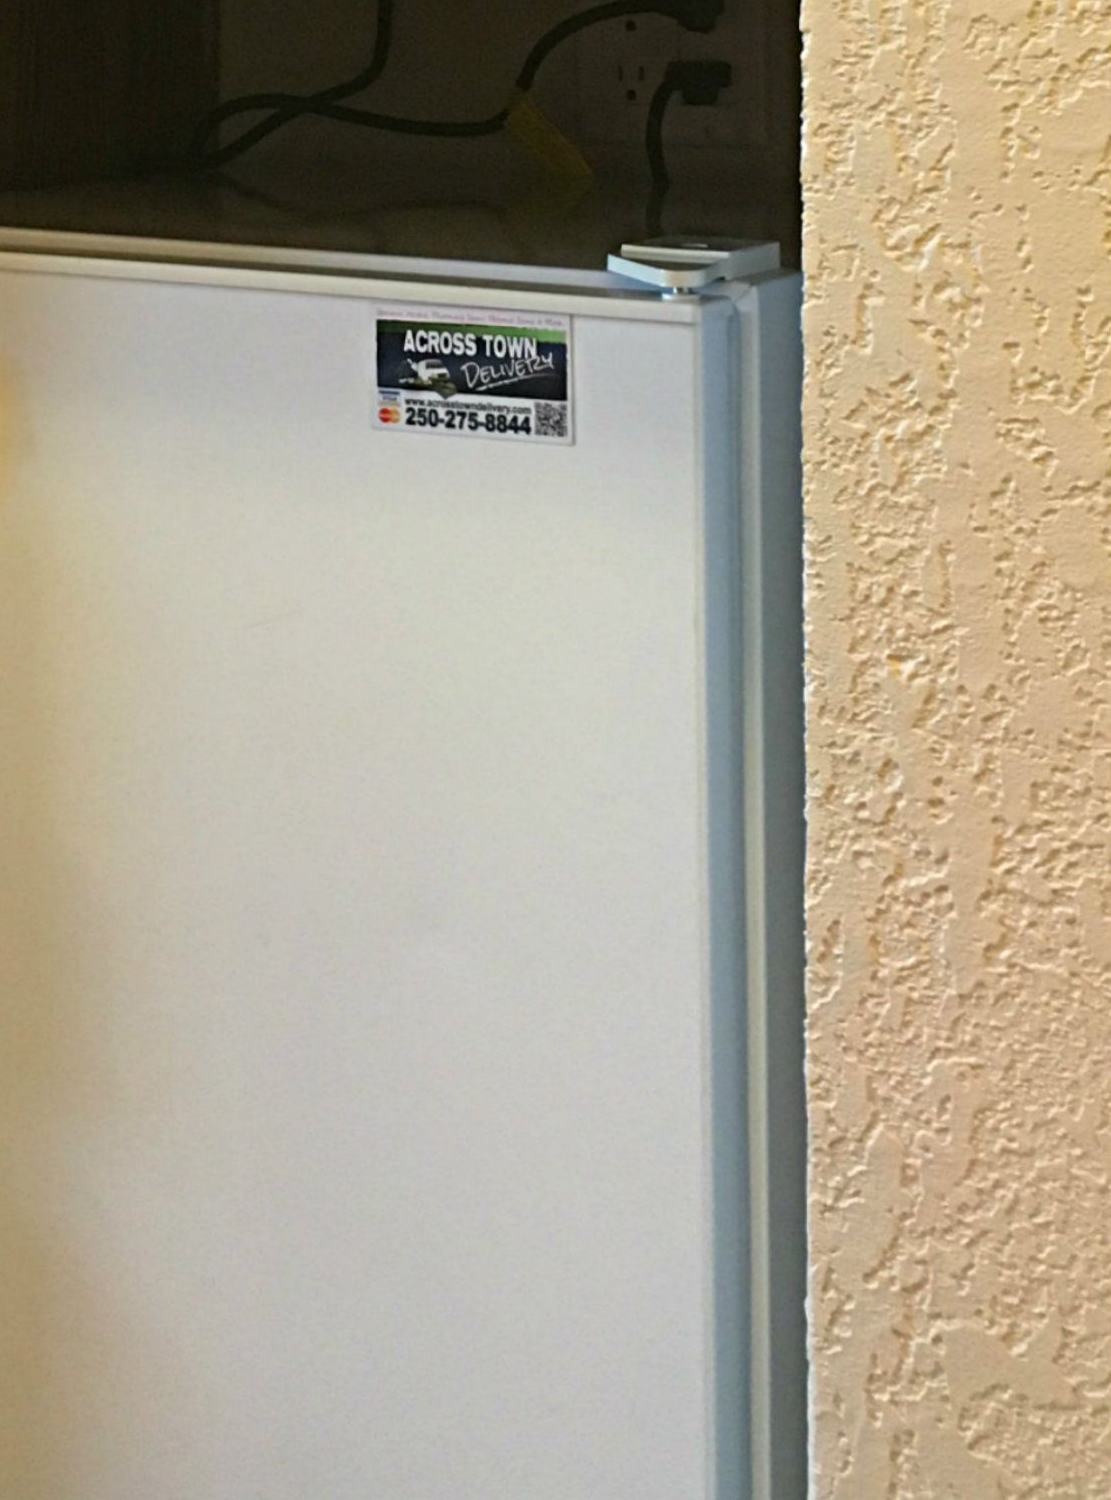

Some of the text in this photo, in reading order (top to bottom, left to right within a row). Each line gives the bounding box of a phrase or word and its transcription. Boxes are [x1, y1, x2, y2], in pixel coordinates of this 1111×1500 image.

[404, 329, 538, 360] ACROSS TOWN
[460, 352, 555, 389] DELIVERY
[404, 398, 532, 415] www.acrosstowndelivery.com
[404, 406, 533, 436] 250-275-8844
